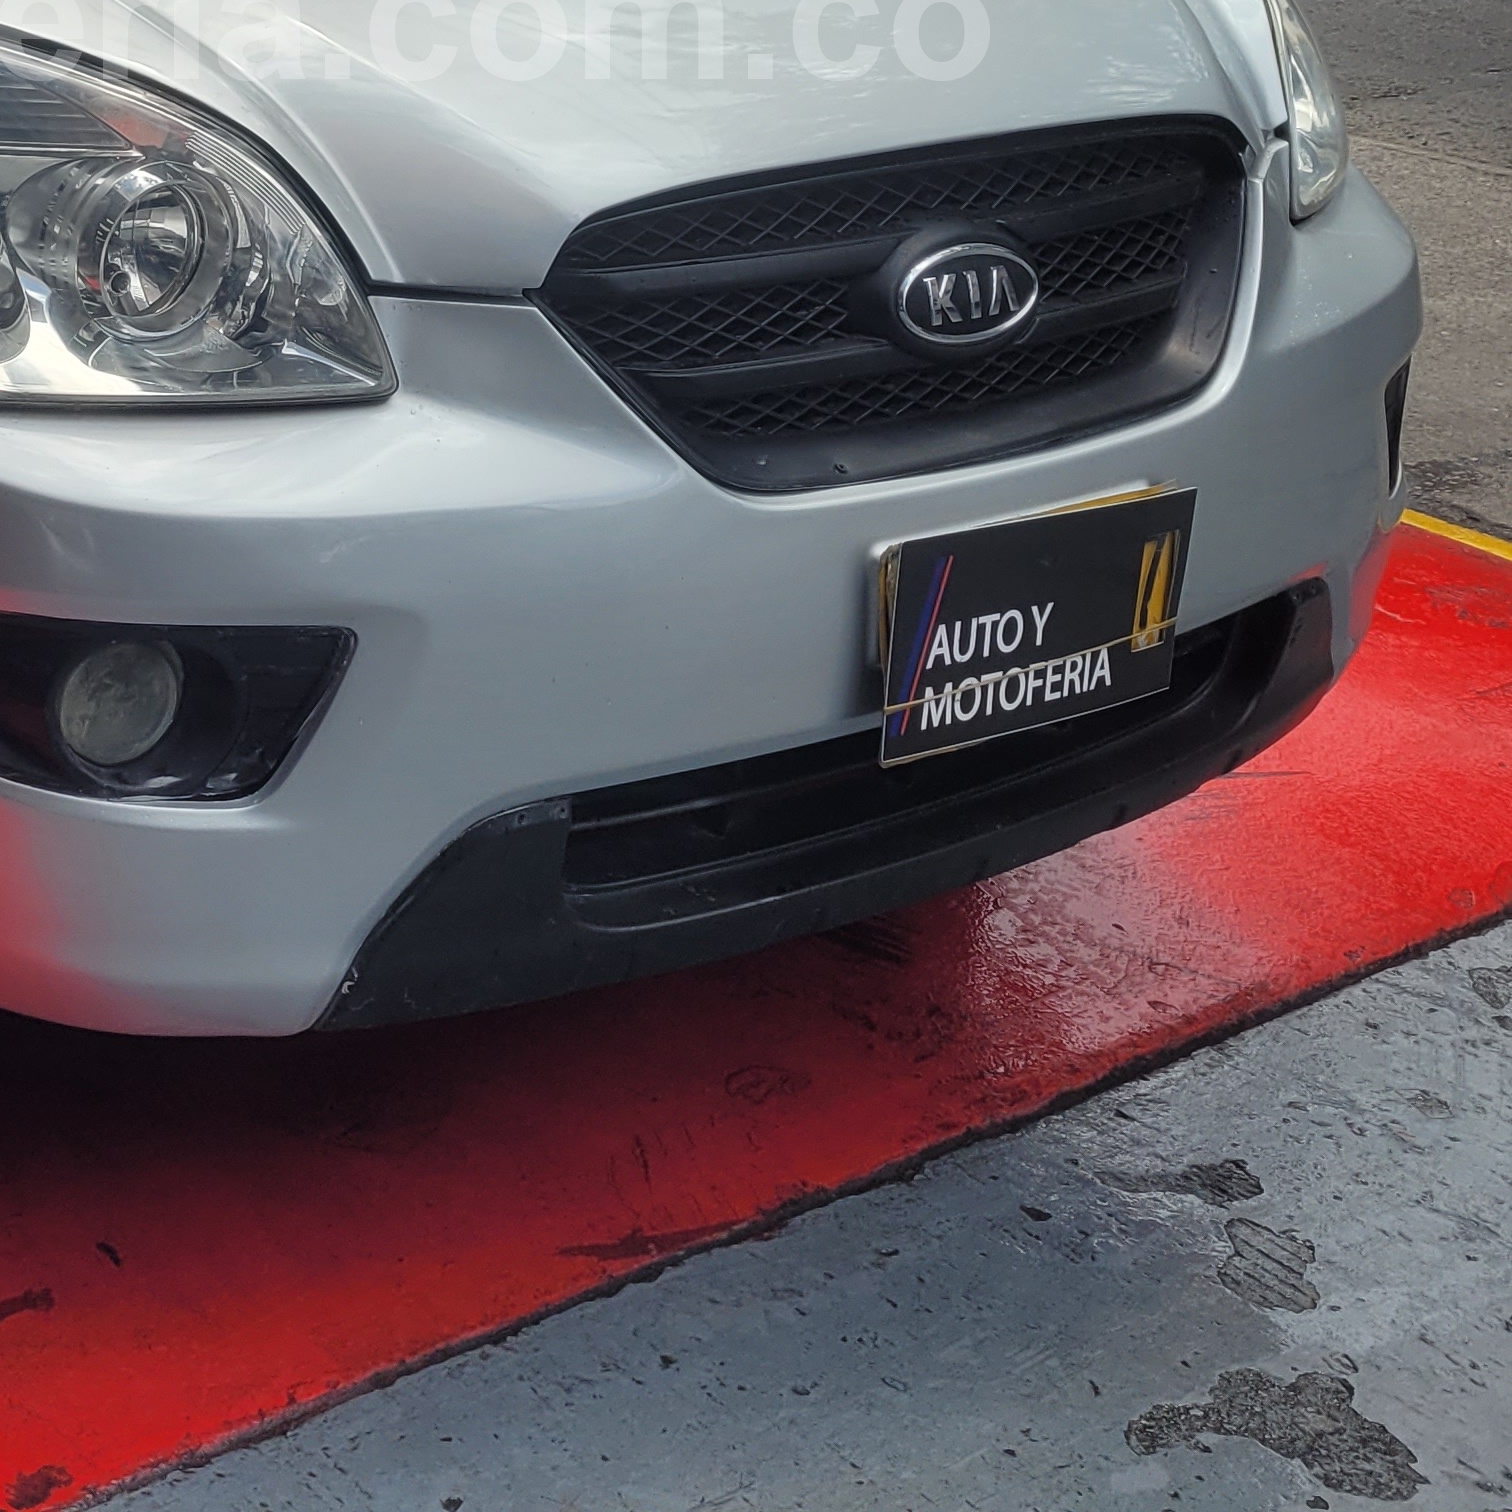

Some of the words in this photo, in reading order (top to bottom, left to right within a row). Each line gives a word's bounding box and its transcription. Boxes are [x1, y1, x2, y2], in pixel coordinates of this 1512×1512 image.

[922, 265, 1020, 326] KIA
[925, 609, 1024, 670] AUTO
[1031, 601, 1055, 647] Y
[920, 646, 1112, 731] MOTOFERIA
